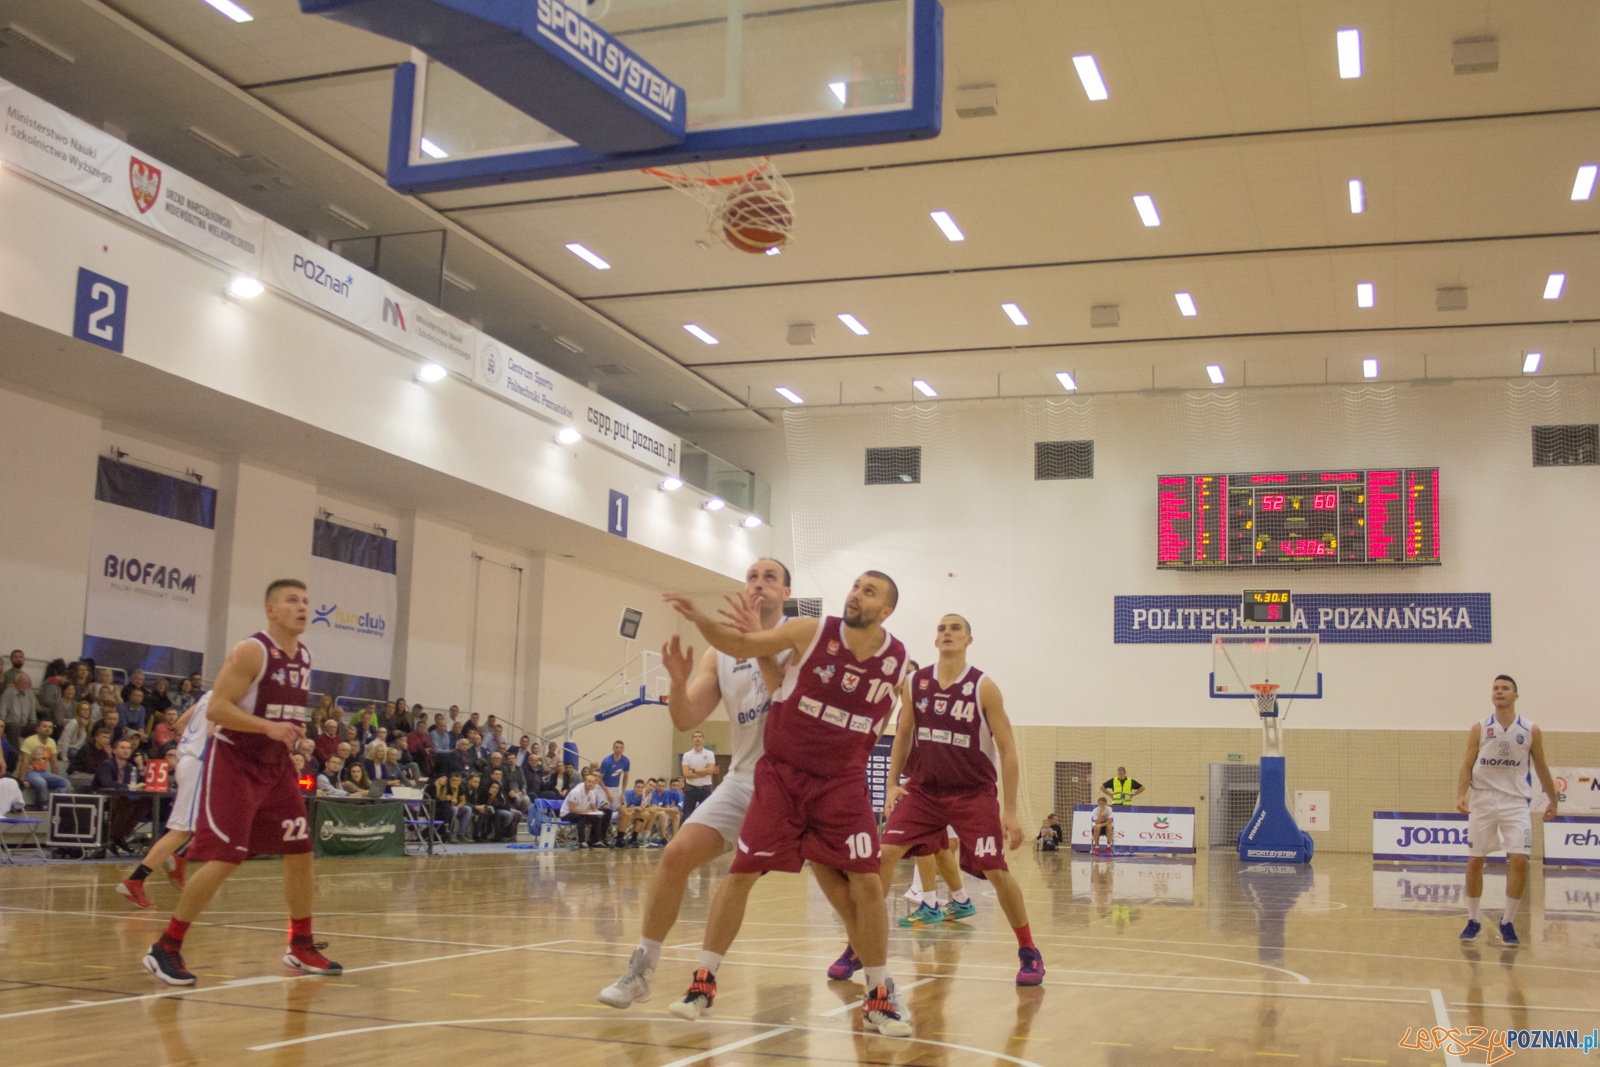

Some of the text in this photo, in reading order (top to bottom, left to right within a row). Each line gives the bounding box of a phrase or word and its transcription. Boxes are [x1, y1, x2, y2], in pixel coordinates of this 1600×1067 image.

[537, 0, 676, 112] SPORT SYSTEM
[5, 121, 9, 132] i
[10, 125, 67, 161] Szkolnictwa
[7, 106, 97, 159] Ministerstwo Nauki
[88, 282, 116, 341] 2
[508, 357, 553, 391] Centrum Sportu
[587, 406, 676, 466] cspp.put.poznan.pl
[615, 497, 622, 532] 1
[1262, 493, 1337, 511] 52 60
[104, 554, 196, 595] BIOFARM
[1254, 593, 1288, 603] 4.30.6
[1132, 603, 1472, 630] POLITECHA POZNAŃSKA
[1268, 604, 1279, 620] 5
[335, 623, 355, 631] biuro
[865, 679, 893, 704] 10
[800, 701, 816, 714] PEC
[950, 700, 975, 722] 44
[1499, 741, 1510, 756] 2
[281, 816, 309, 841] 22
[1139, 832, 1183, 840] CYMES
[1564, 829, 1600, 846] reh
[845, 832, 873, 859] 10
[975, 836, 997, 857] 44
